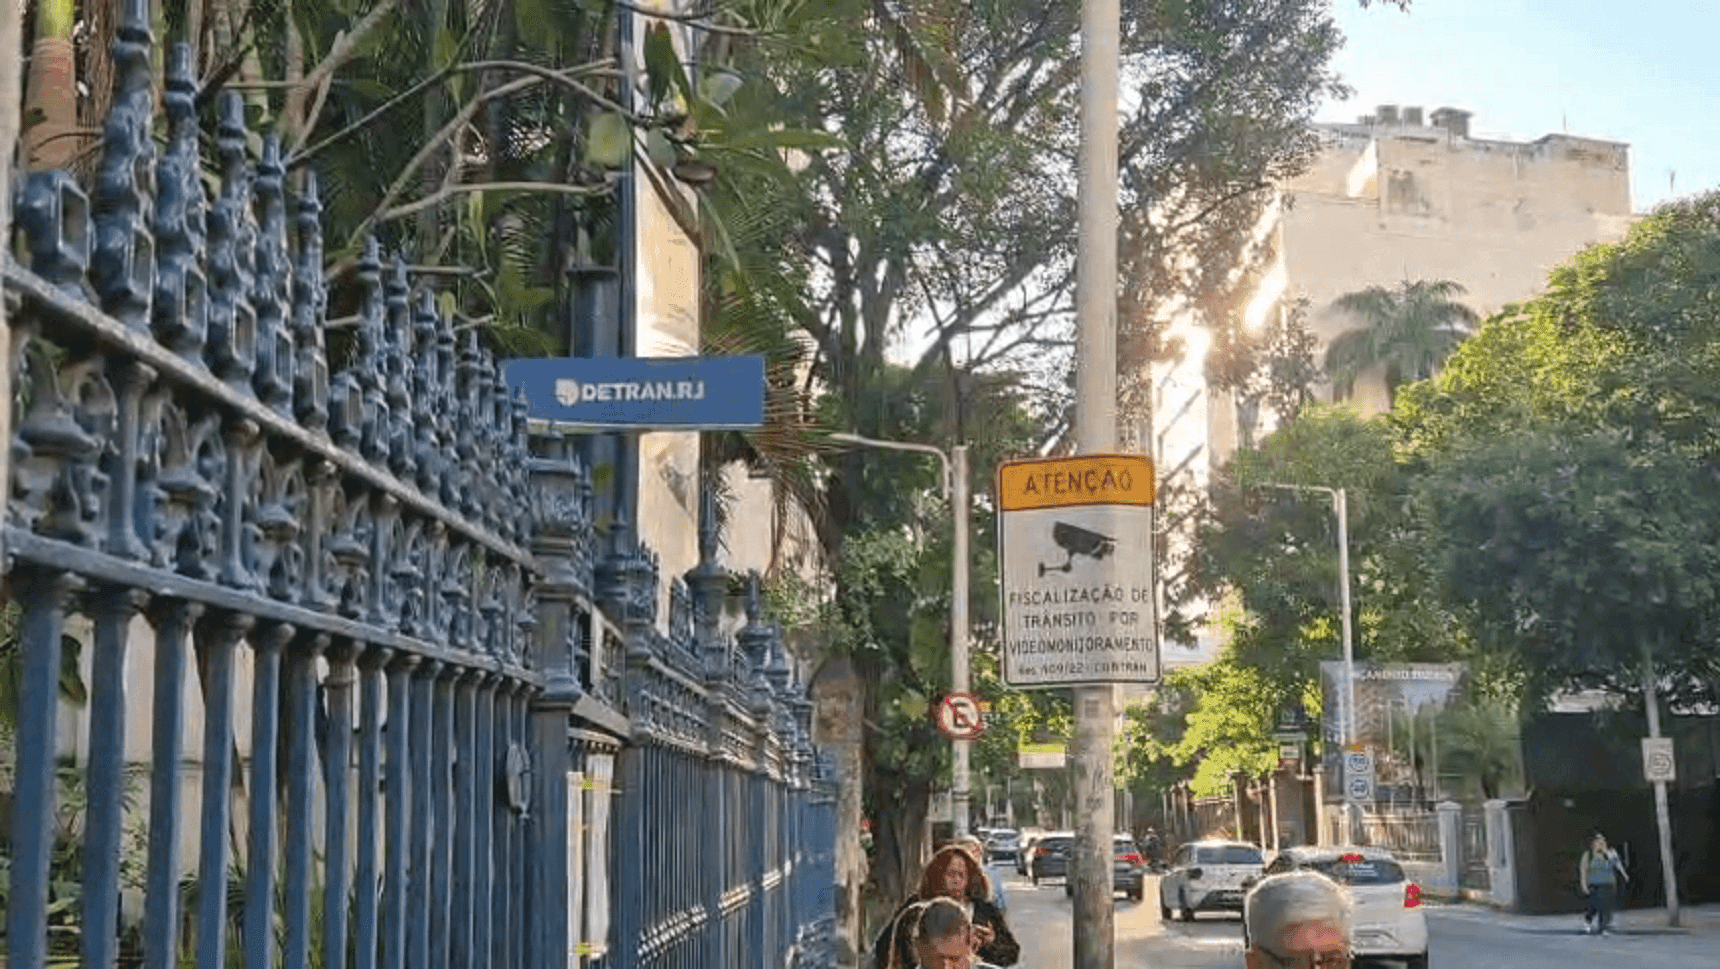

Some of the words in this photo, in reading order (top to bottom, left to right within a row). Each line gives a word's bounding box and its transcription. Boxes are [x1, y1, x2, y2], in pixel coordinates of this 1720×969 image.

[582, 380, 704, 401] DETRAN.RJ
[1009, 583, 1124, 606] FISCALIZAÇÃO
[1131, 586, 1149, 604] DE
[1022, 609, 1096, 628] TRÂNSITO
[1109, 611, 1139, 625] POR
